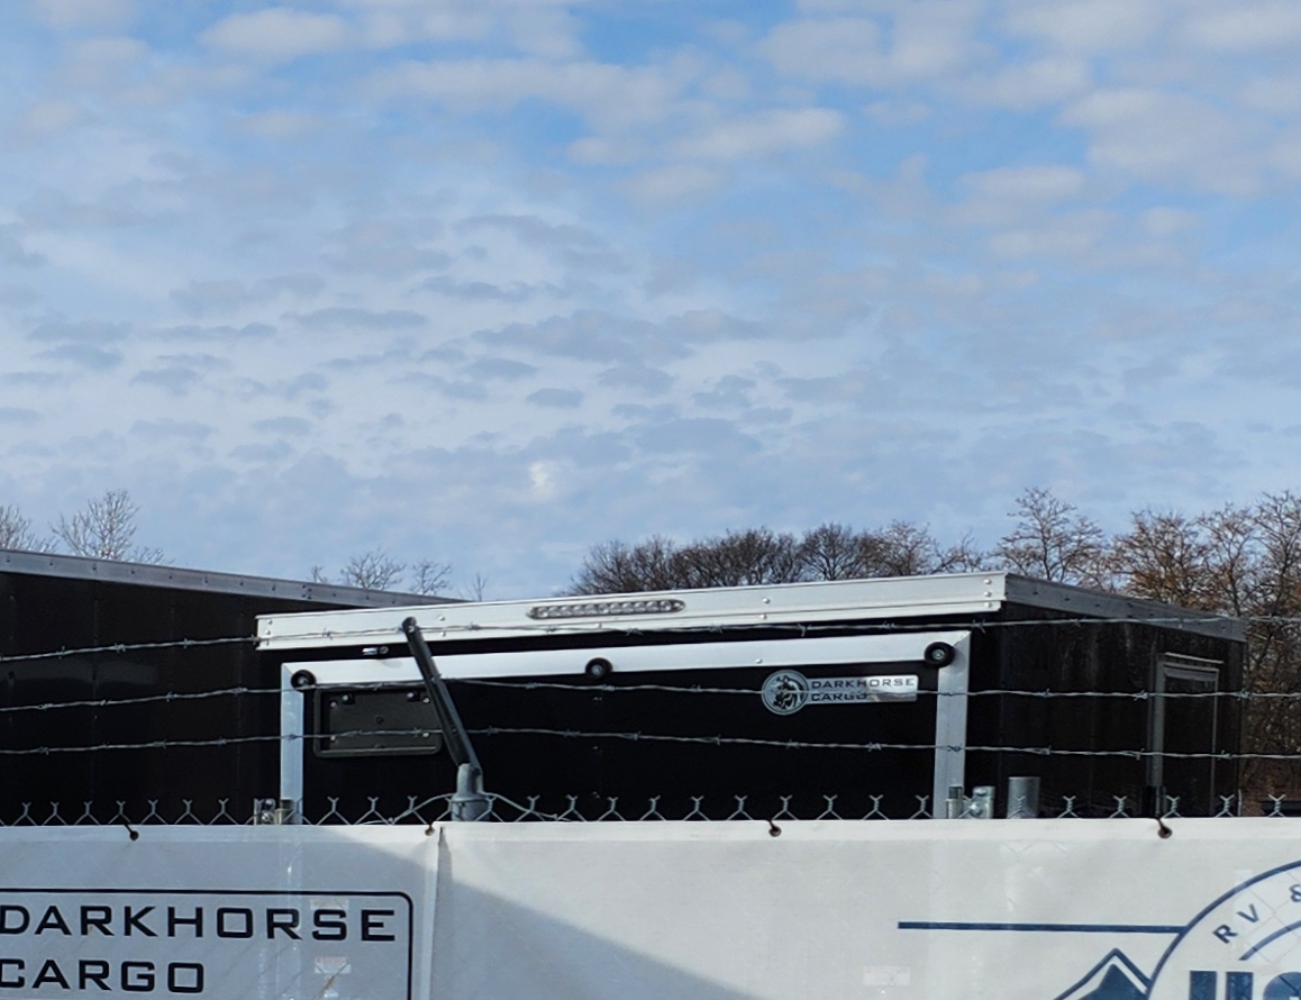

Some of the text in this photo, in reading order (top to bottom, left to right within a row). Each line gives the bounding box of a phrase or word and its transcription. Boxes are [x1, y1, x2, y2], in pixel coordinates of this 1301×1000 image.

[811, 678, 915, 690] DARKHORSE
[811, 692, 868, 702] CARGO
[0, 905, 396, 942] DARKHORSE
[1212, 903, 1259, 945] RV
